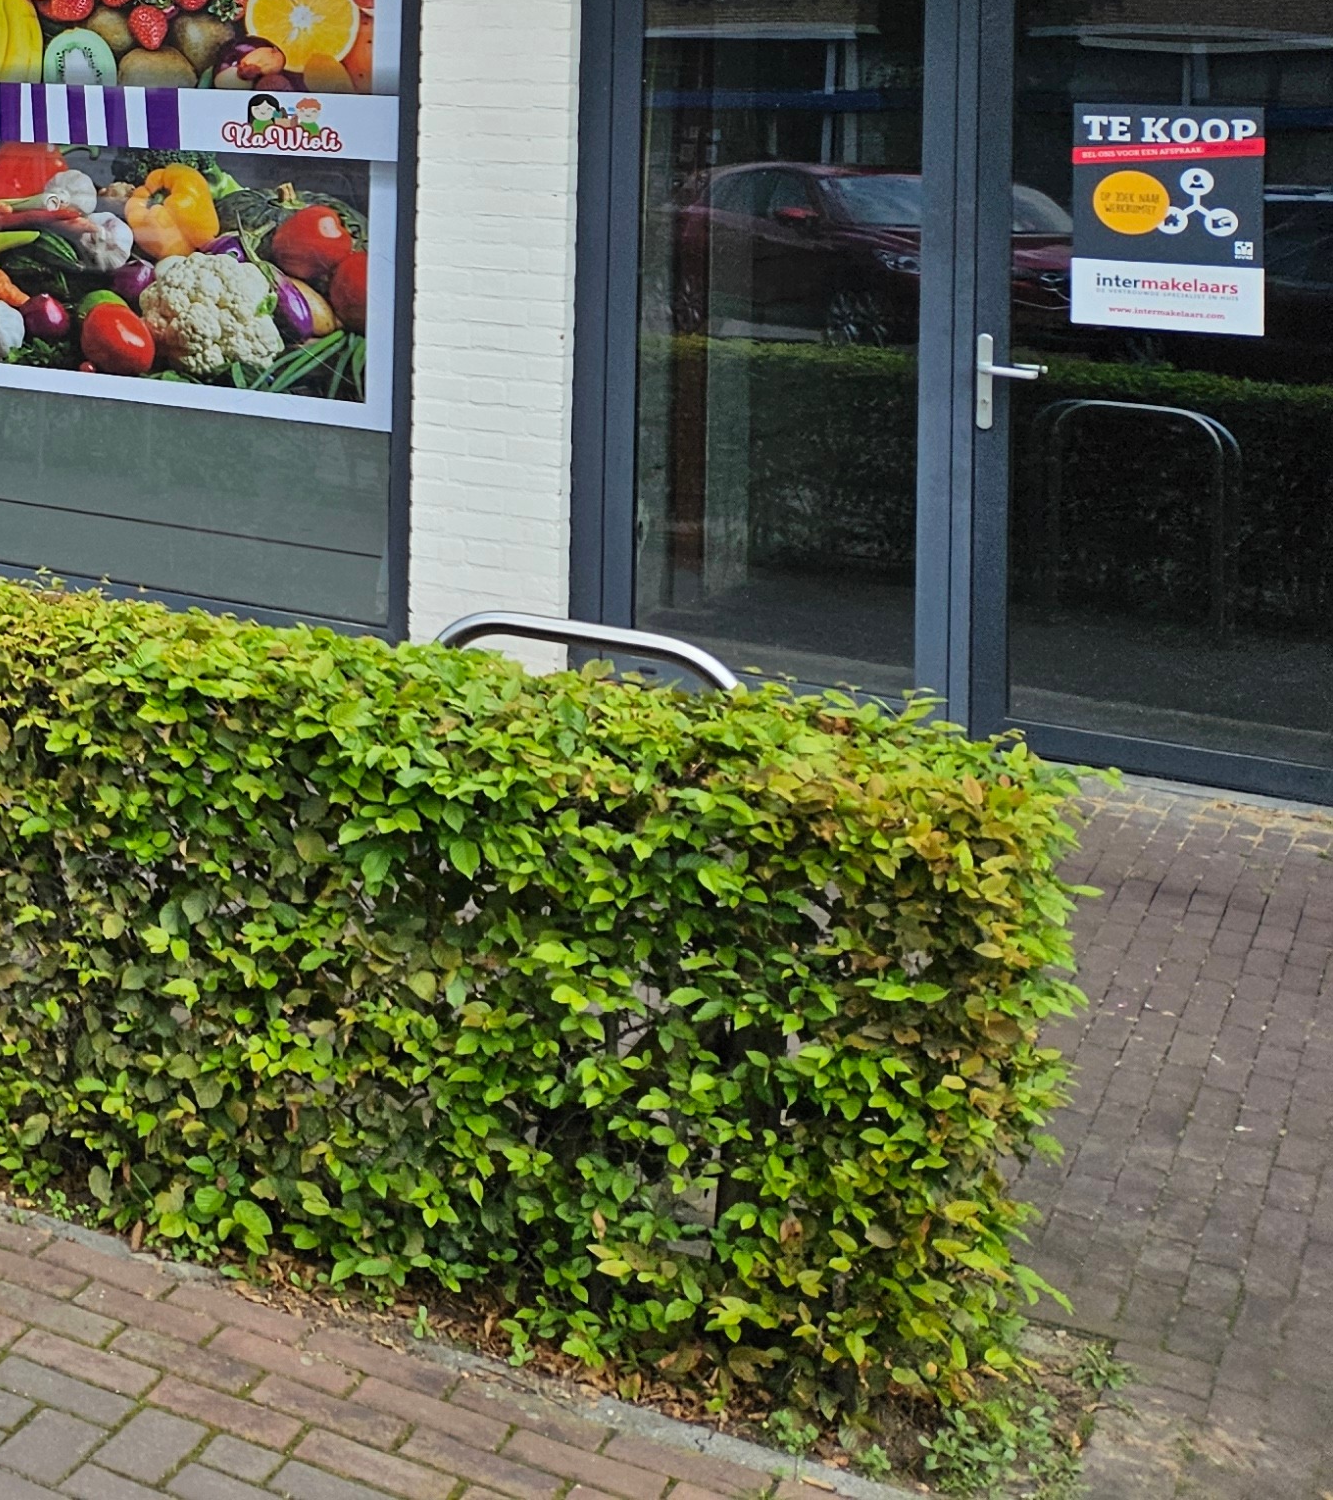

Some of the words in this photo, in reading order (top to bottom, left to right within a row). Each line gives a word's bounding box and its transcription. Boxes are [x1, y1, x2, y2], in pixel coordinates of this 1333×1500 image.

[1083, 115, 1131, 141] TE
[1141, 117, 1257, 144] KOOP
[1082, 151, 1097, 159] BEL
[1117, 149, 1140, 157] VOOR
[1141, 148, 1158, 156] EEN
[1096, 272, 1239, 295] intermakelaars
[1108, 305, 1226, 320] www.intermakelaars.com
